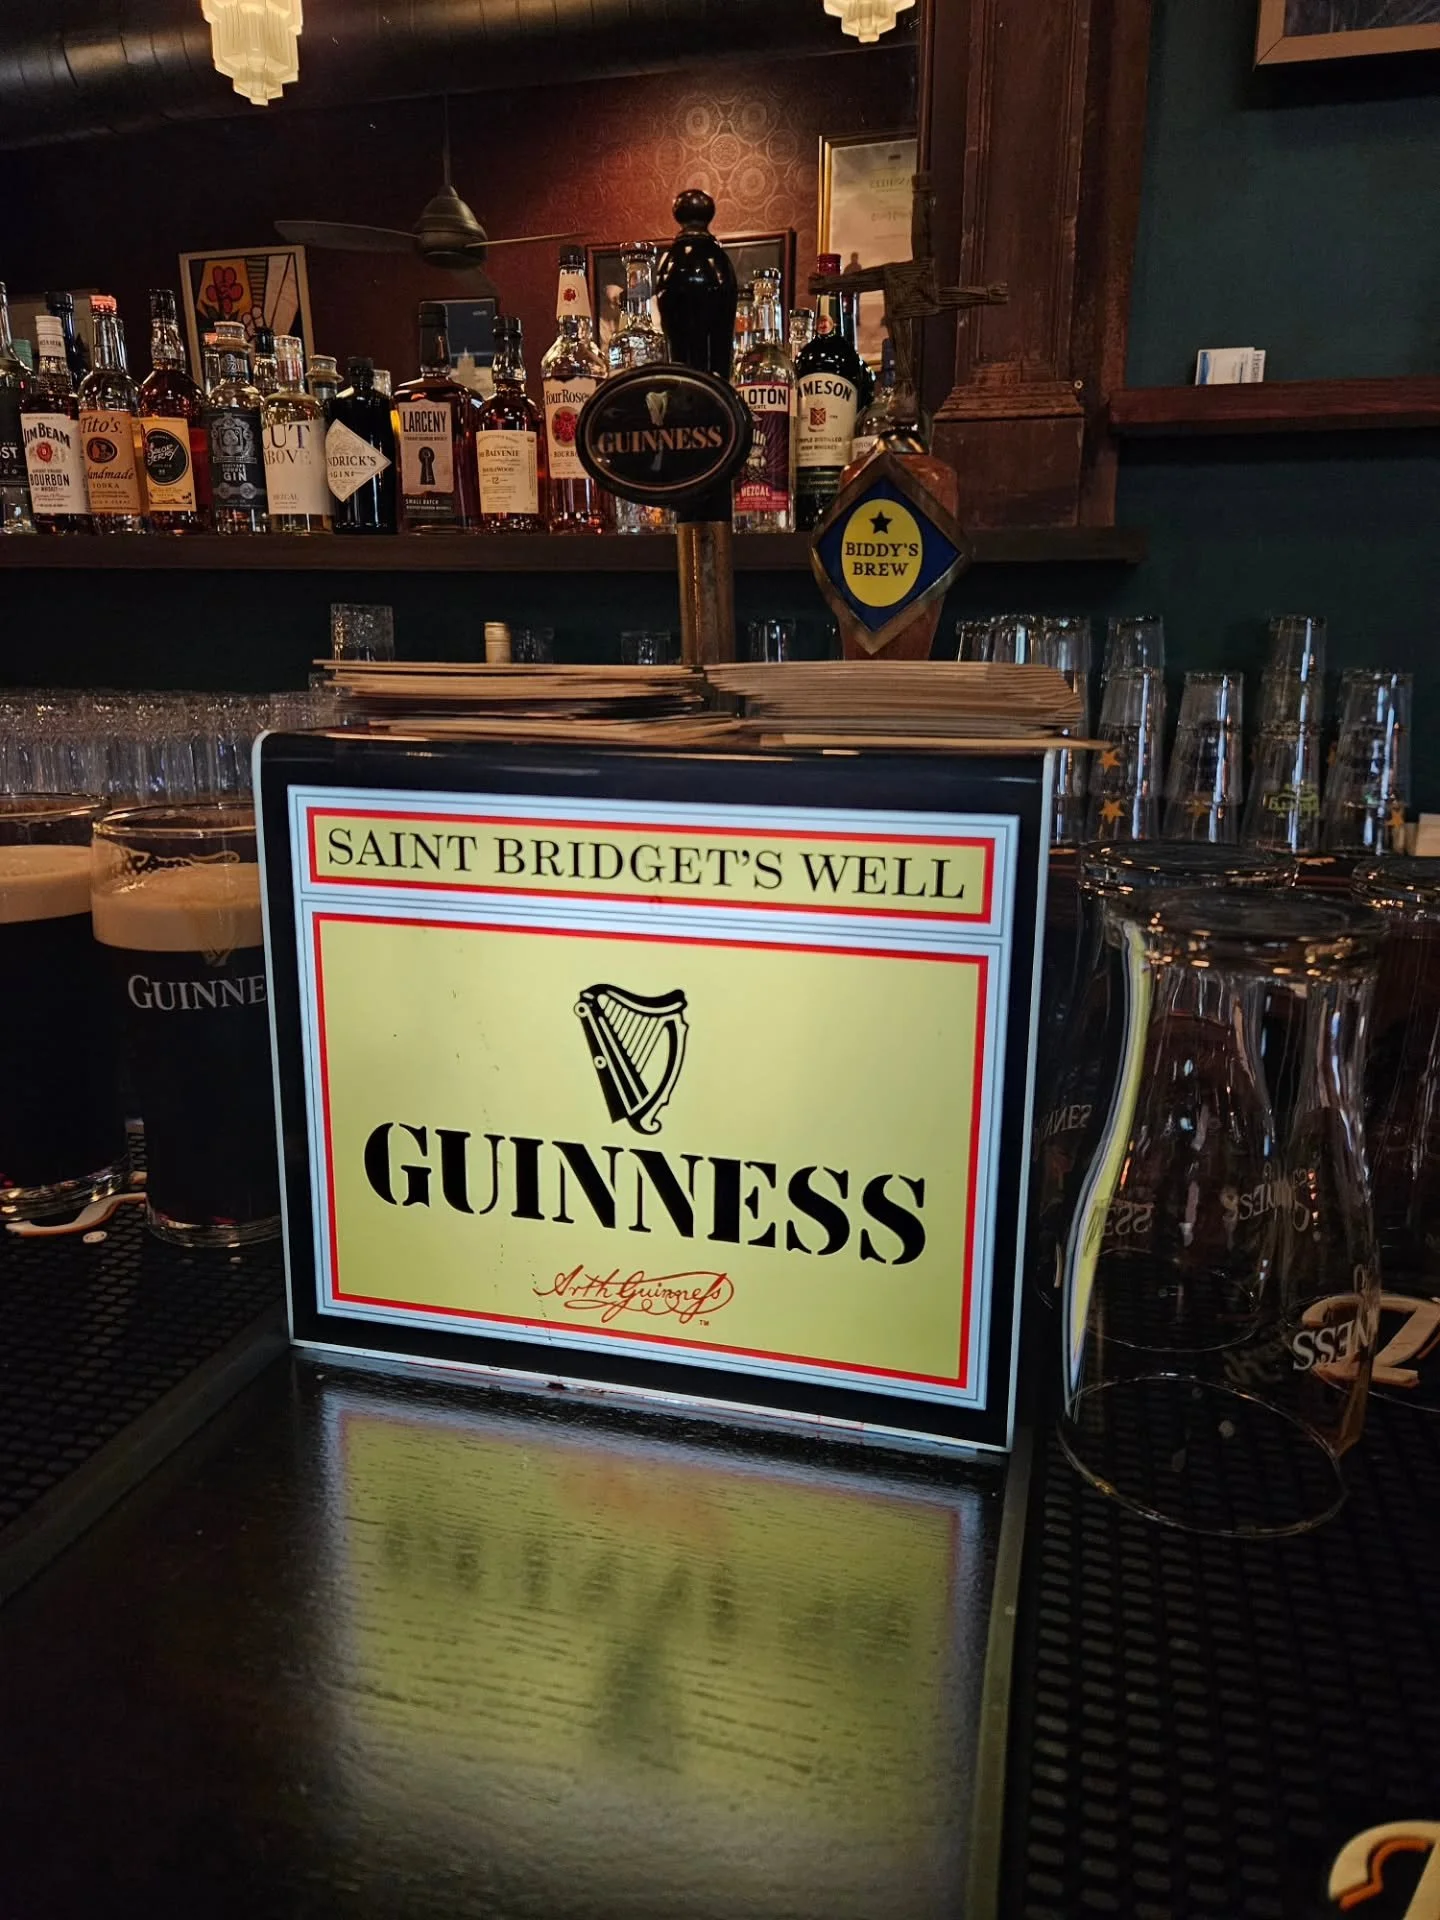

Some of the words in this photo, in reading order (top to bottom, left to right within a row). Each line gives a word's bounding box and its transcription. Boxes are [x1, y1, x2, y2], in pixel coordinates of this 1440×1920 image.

[81, 416, 121, 434] Tito's
[402, 410, 447, 433] LARCENY
[23, 427, 38, 448] JIM
[37, 422, 71, 449] BEAM
[597, 425, 724, 454] GUINNESS
[0, 446, 18, 459] ST
[553, 450, 578, 458] BOURB
[29, 473, 71, 487] BOURBON
[223, 472, 247, 481] GIN
[740, 485, 771, 497] MEZCAL
[845, 541, 919, 557] BIDDY'S
[852, 562, 909, 577] BREW
[326, 828, 478, 873] SAINT
[493, 837, 784, 891] BRIDGET'S
[799, 852, 966, 900] WELL
[363, 1120, 927, 1267] GUINNESS
